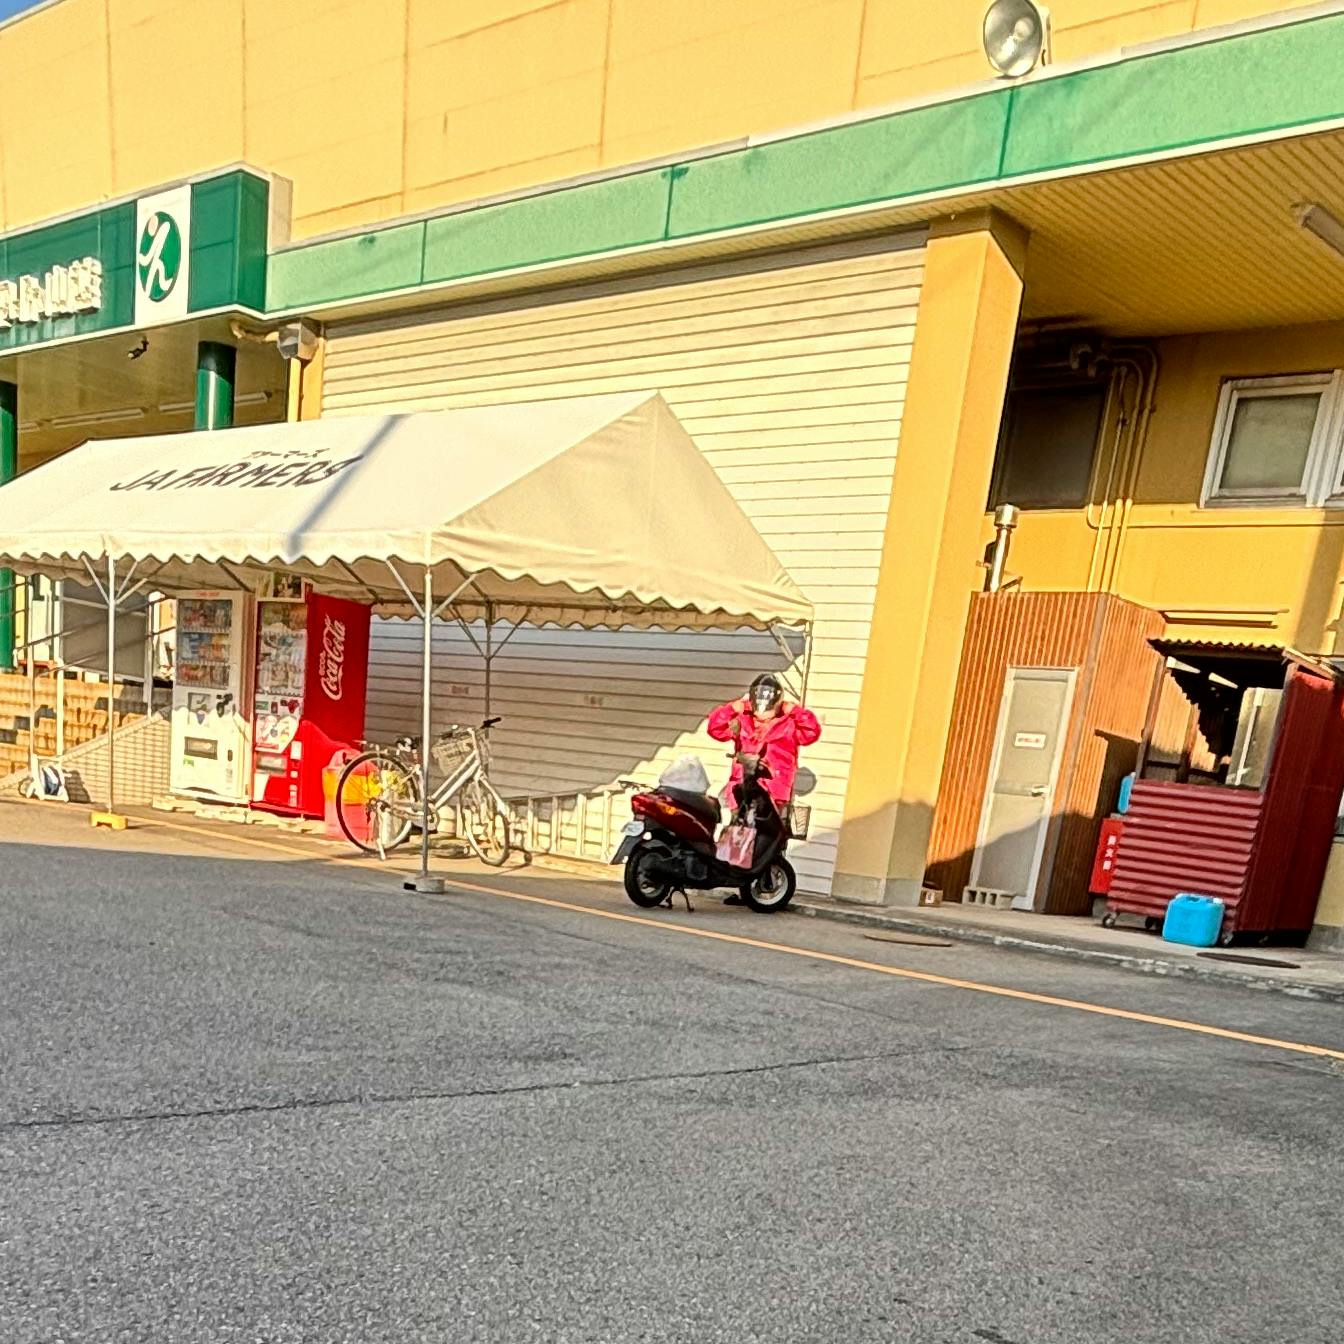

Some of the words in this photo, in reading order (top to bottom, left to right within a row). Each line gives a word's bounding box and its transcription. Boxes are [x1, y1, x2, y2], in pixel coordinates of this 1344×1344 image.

[110, 468, 178, 491] JA
[174, 453, 364, 488] FARMERS
[320, 612, 346, 700] Coca-Cola
